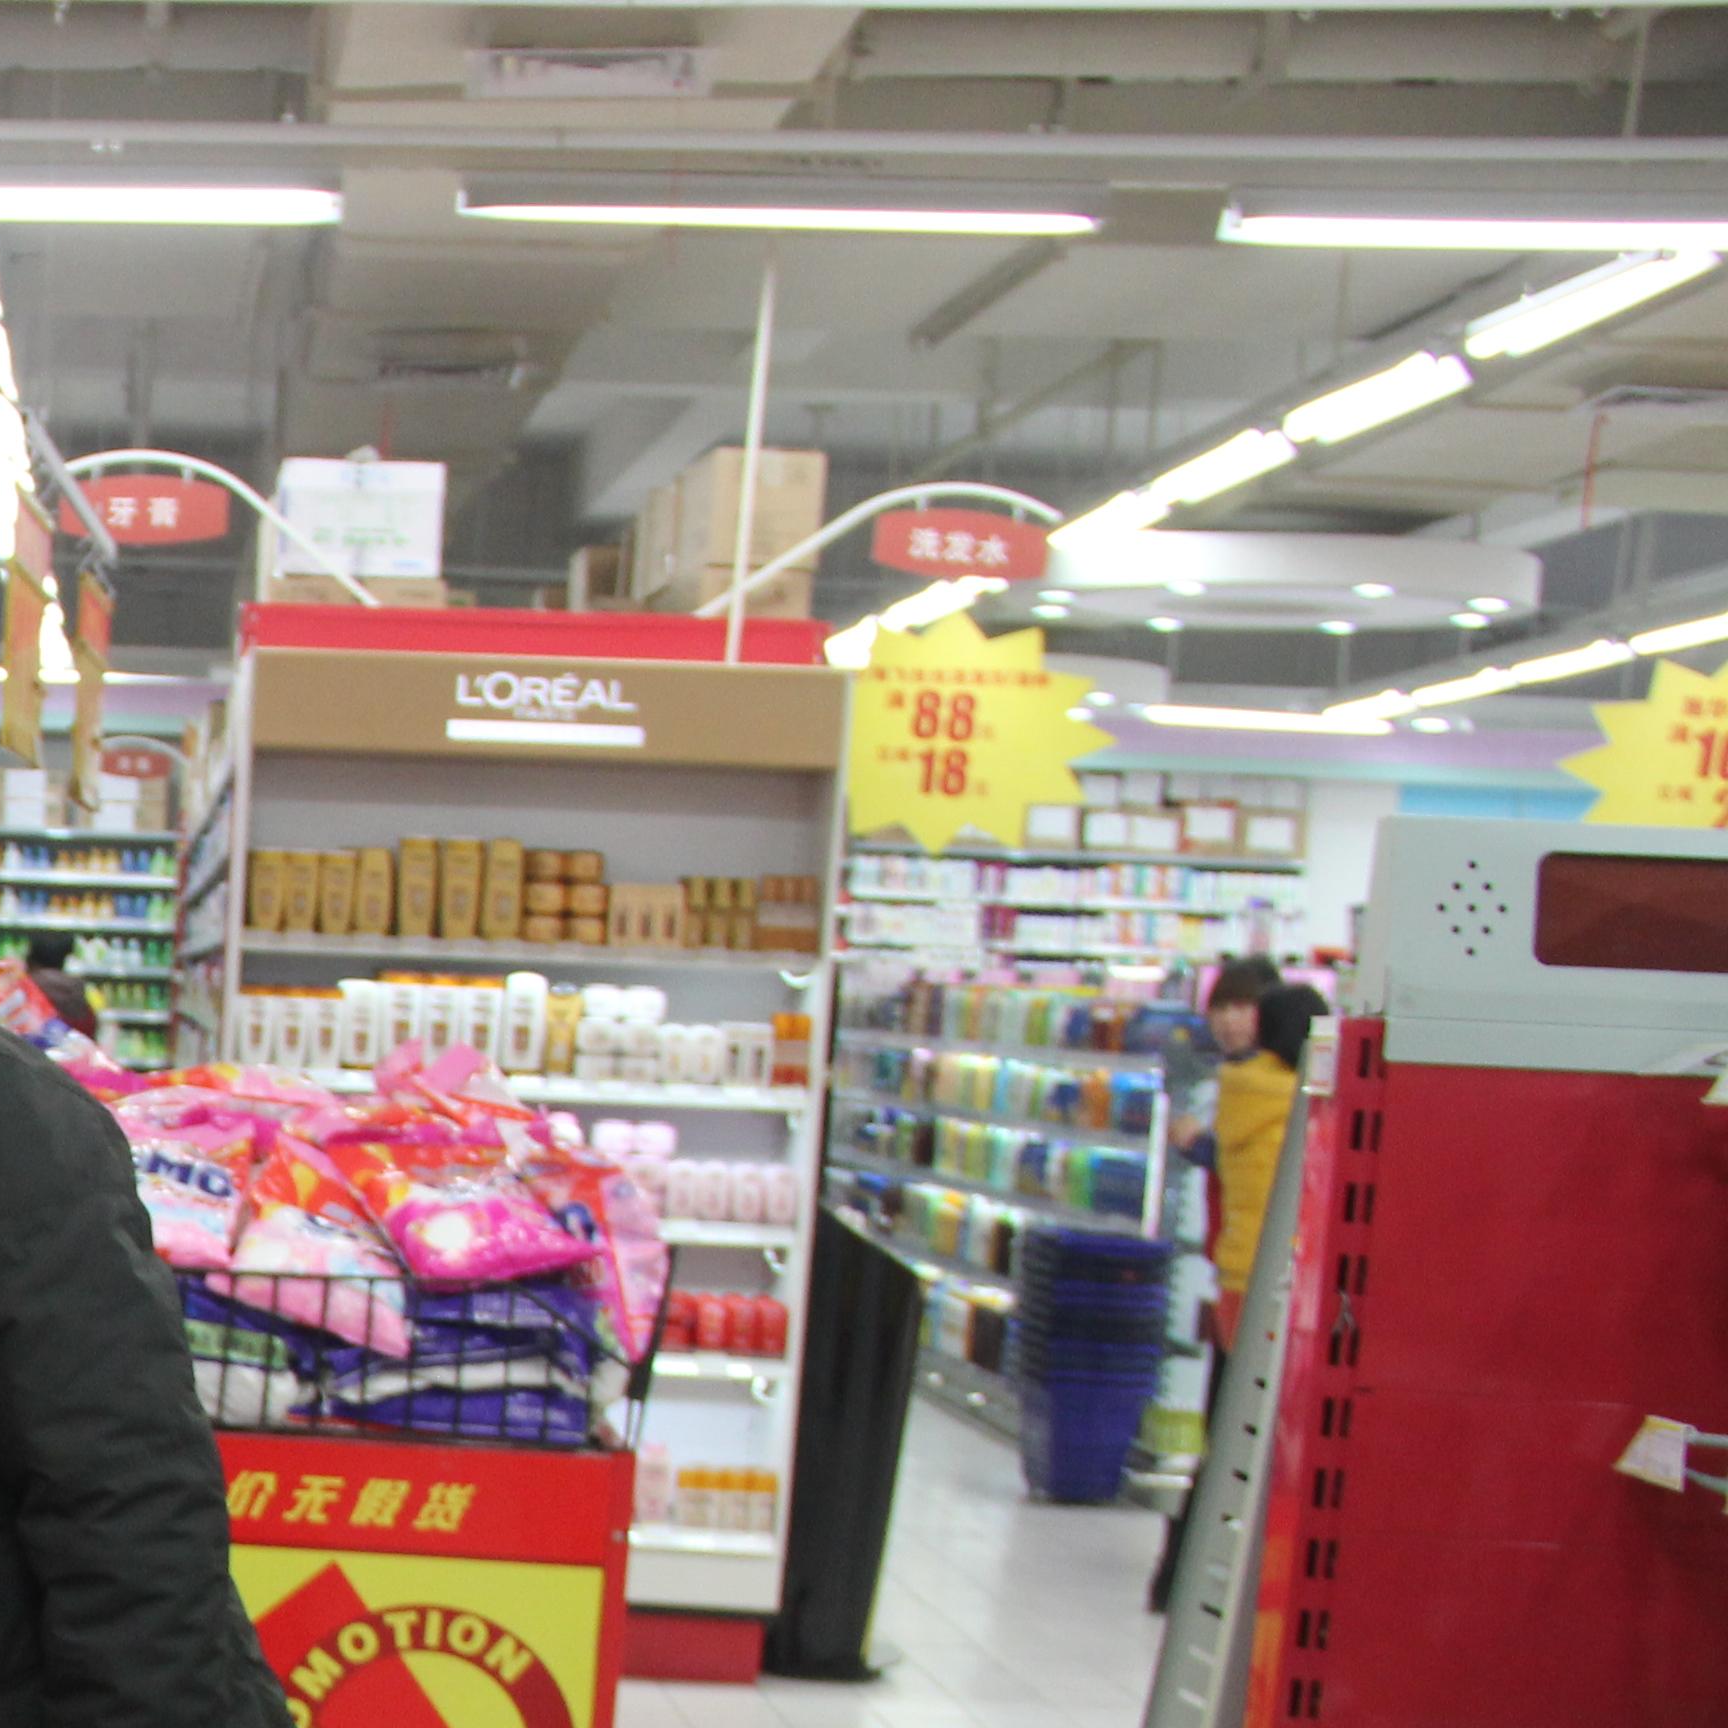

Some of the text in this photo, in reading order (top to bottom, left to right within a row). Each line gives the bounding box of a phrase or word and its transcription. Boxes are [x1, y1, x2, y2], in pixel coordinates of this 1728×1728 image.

[107, 497, 181, 529] 牙膏
[908, 527, 1010, 567] 洗发水
[454, 671, 640, 712] L'ORÉAL
[912, 689, 976, 742] 88
[919, 749, 970, 797] 18
[135, 1146, 232, 1198] MO
[226, 1470, 477, 1533] 价无假货
